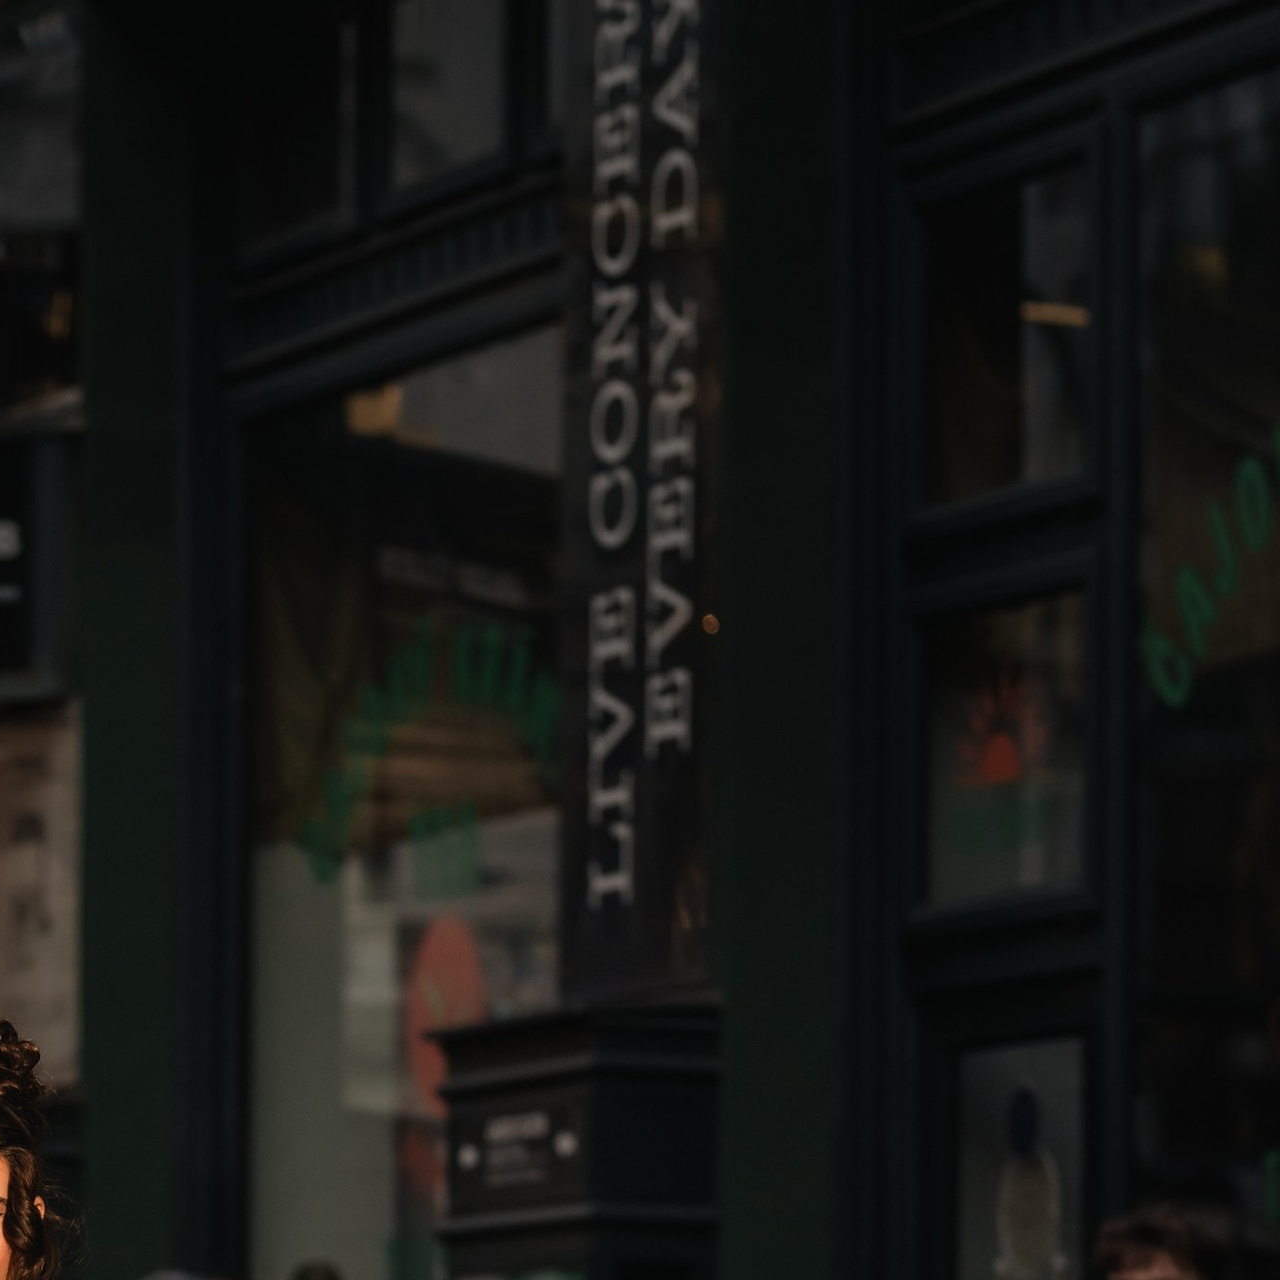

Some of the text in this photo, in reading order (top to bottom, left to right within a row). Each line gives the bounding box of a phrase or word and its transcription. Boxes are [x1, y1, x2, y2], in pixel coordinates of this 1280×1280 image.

[588, 0, 642, 909] LIVE CONCER
[646, 284, 698, 759] EVERY
